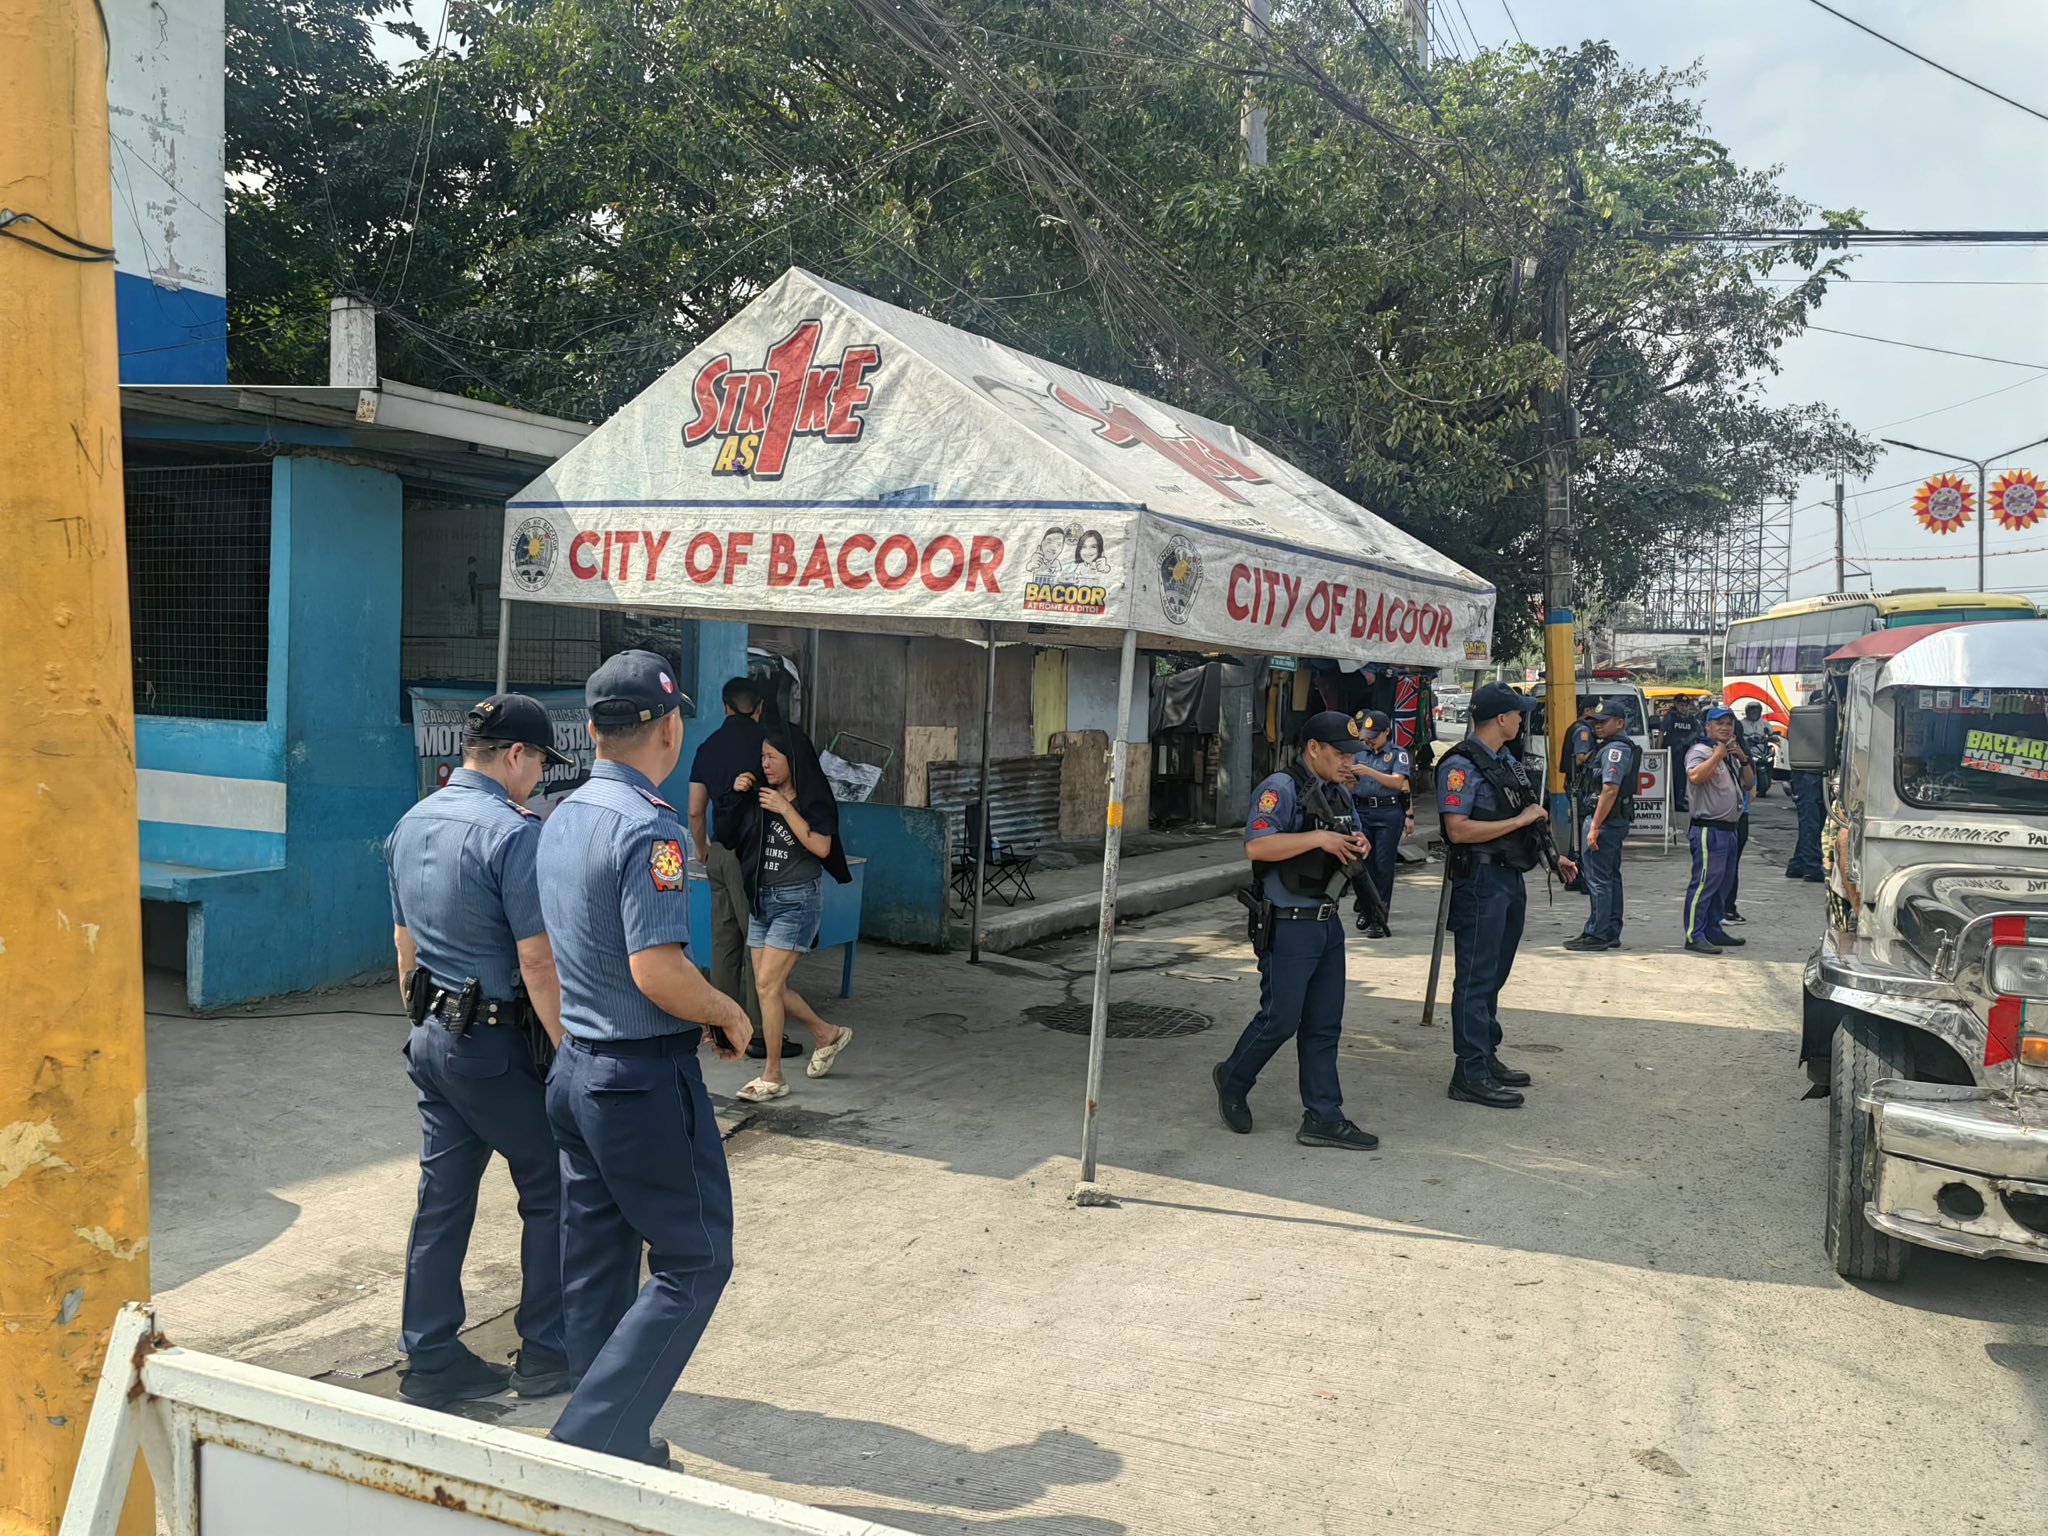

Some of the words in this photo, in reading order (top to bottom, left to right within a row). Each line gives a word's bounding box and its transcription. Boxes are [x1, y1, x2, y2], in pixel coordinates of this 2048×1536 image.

[713, 435, 760, 472] AS
[568, 530, 671, 581] CITY
[684, 531, 754, 585] OF
[766, 532, 1006, 593] BACOOR
[1024, 582, 1107, 606] BACOOR
[1038, 603, 1064, 611] HOME
[1226, 563, 1302, 628] CITY
[1305, 580, 1349, 634] OF
[1350, 588, 1453, 648] BACOOR
[769, 820, 795, 846] PERSON
